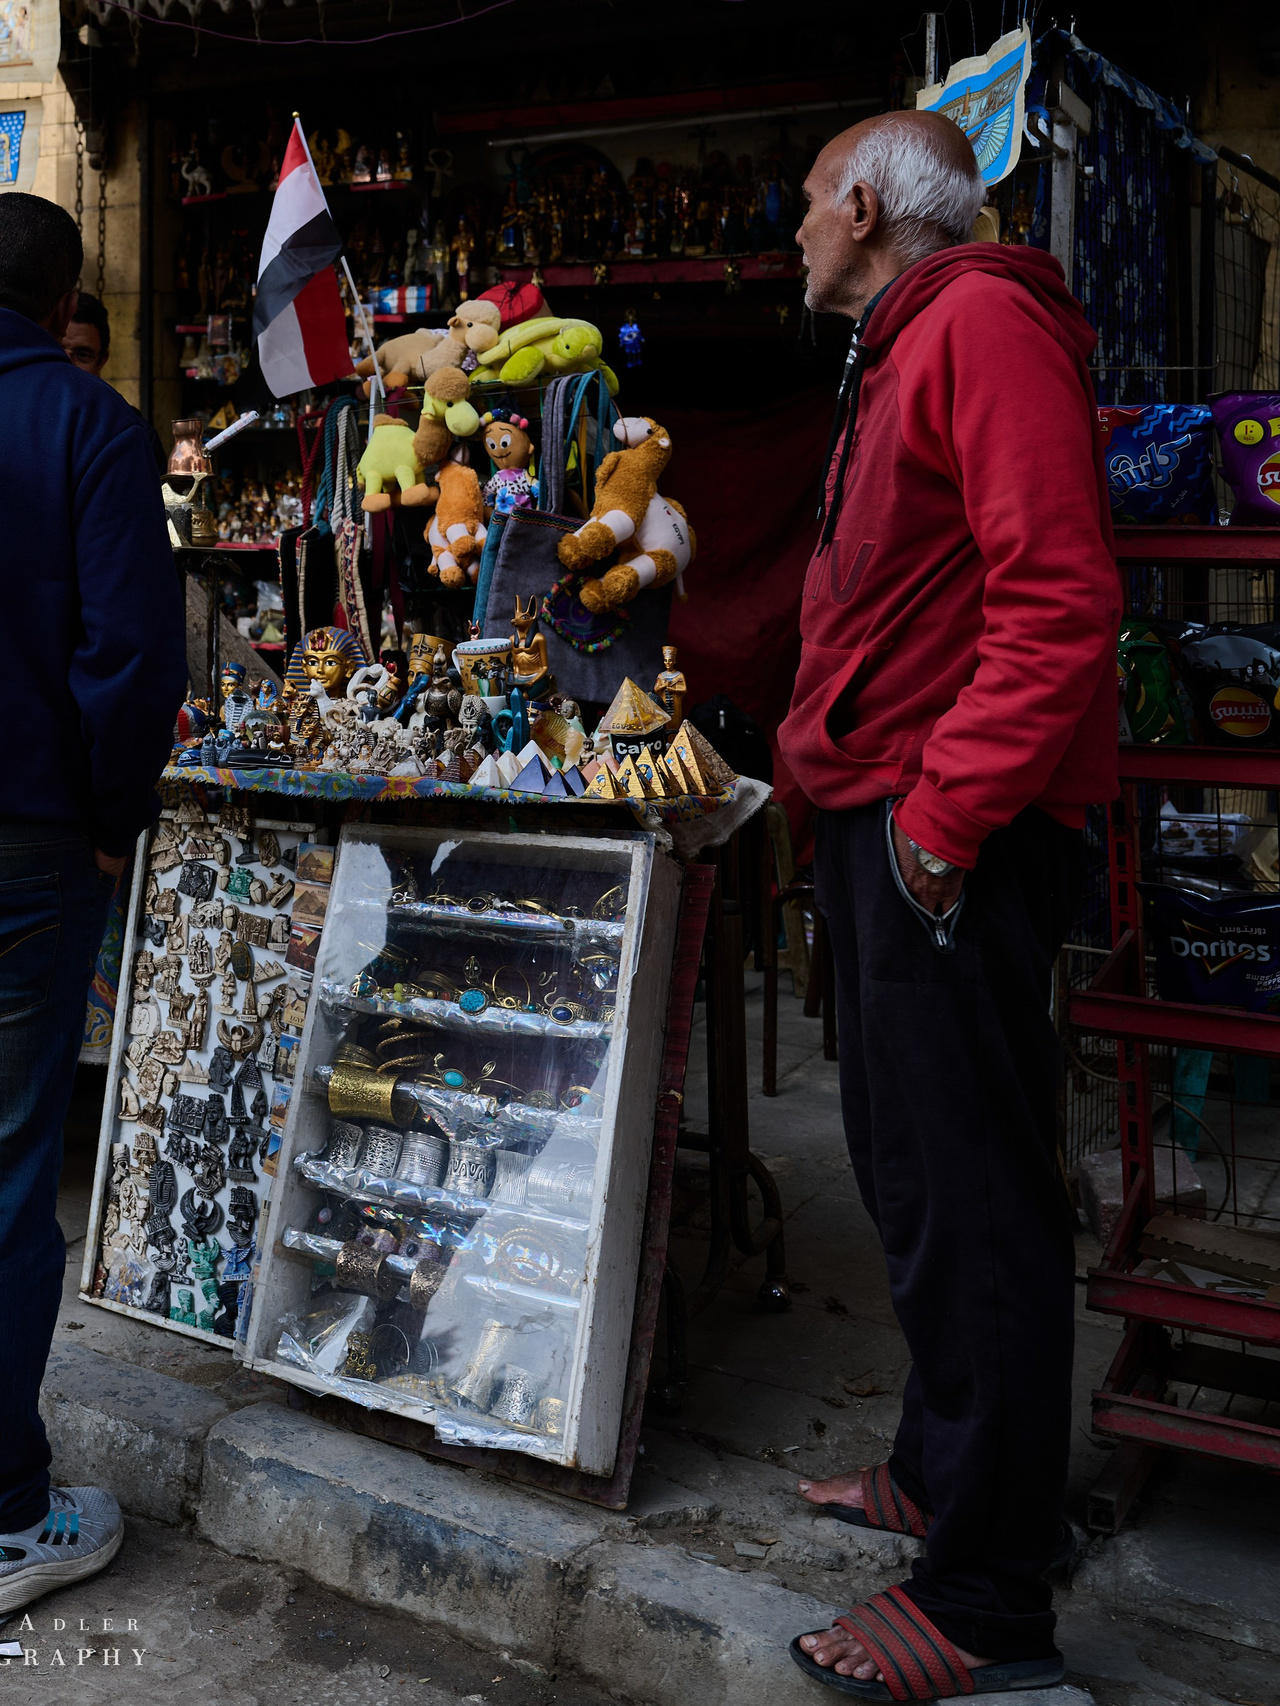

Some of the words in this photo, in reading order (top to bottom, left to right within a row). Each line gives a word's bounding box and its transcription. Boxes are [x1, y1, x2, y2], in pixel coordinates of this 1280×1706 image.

[672, 523, 685, 546] EGYPT
[615, 740, 661, 755] Cairo
[1168, 936, 1271, 962] Doritos
[289, 1014, 305, 1025] EGYP
